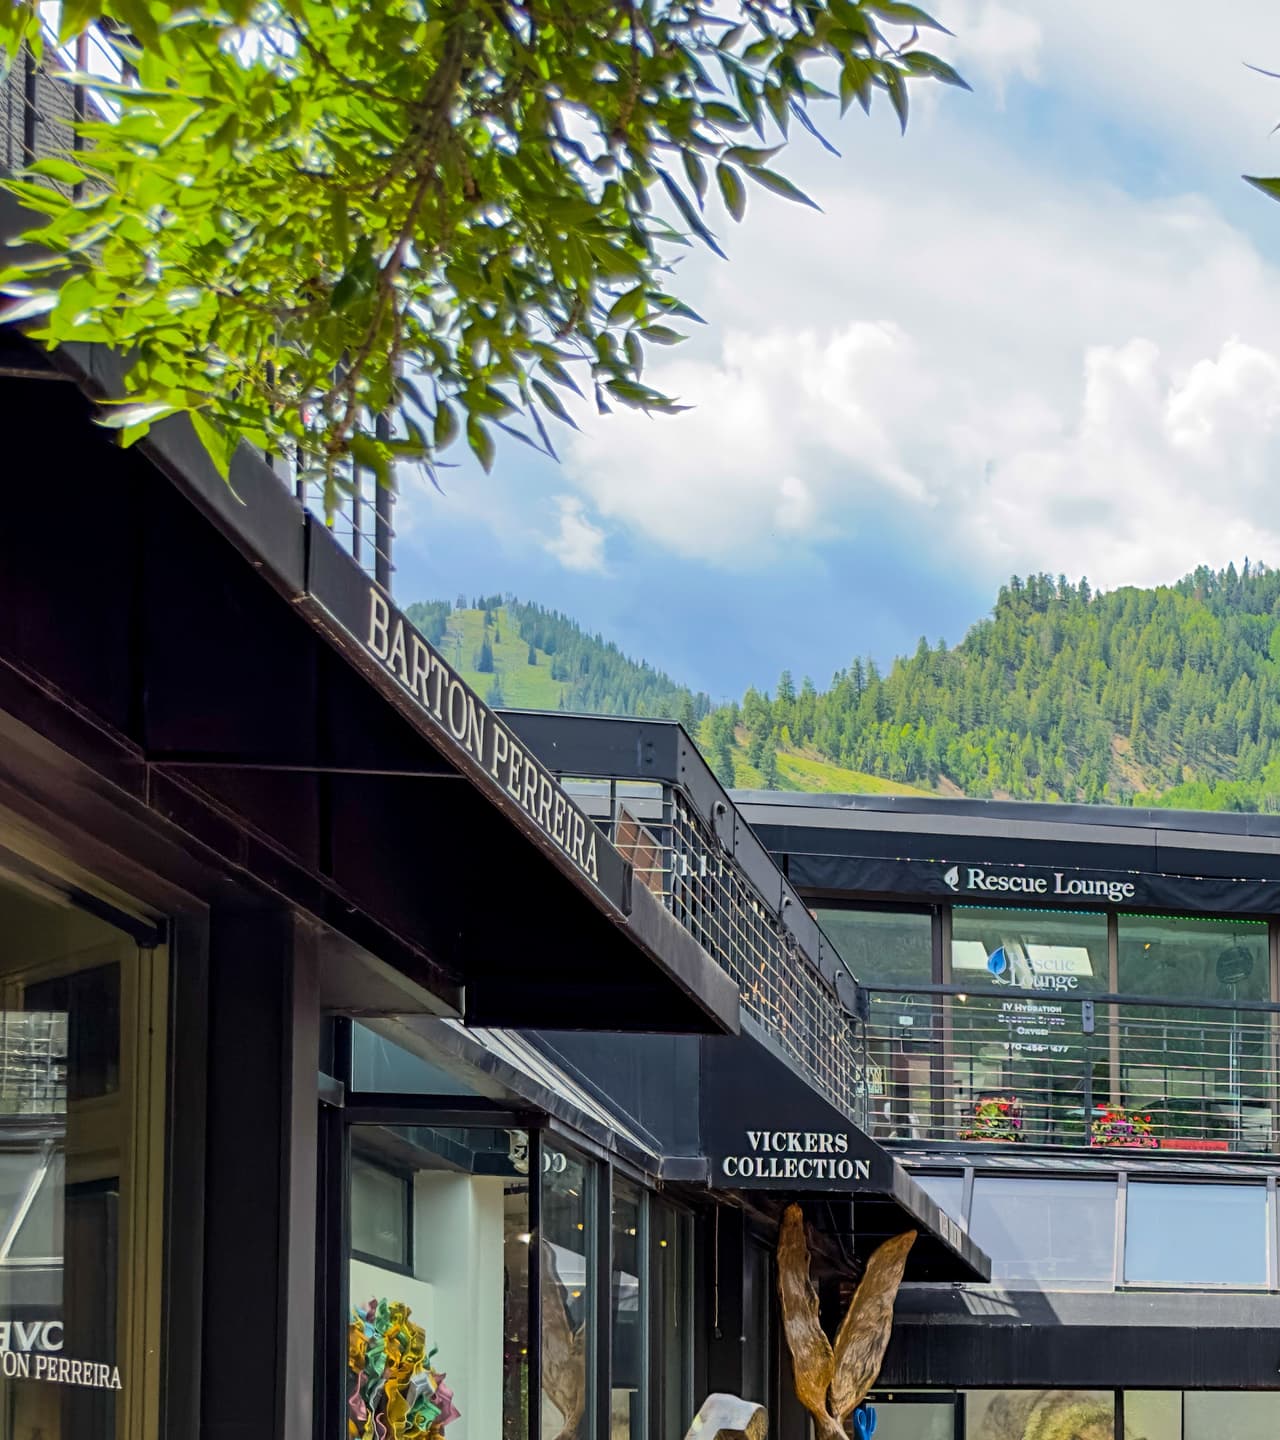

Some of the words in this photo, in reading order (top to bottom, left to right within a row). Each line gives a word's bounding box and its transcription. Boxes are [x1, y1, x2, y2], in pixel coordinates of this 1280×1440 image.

[366, 587, 486, 762] BARTON
[491, 722, 599, 882] PERREIRA
[967, 868, 1048, 893] Rescue
[1053, 873, 1135, 902] Lounge
[747, 1131, 848, 1153] VICKERS
[722, 1157, 871, 1180] COLLECTION
[0, 1350, 30, 1378] ON
[34, 1355, 122, 1389] PERREIRA
